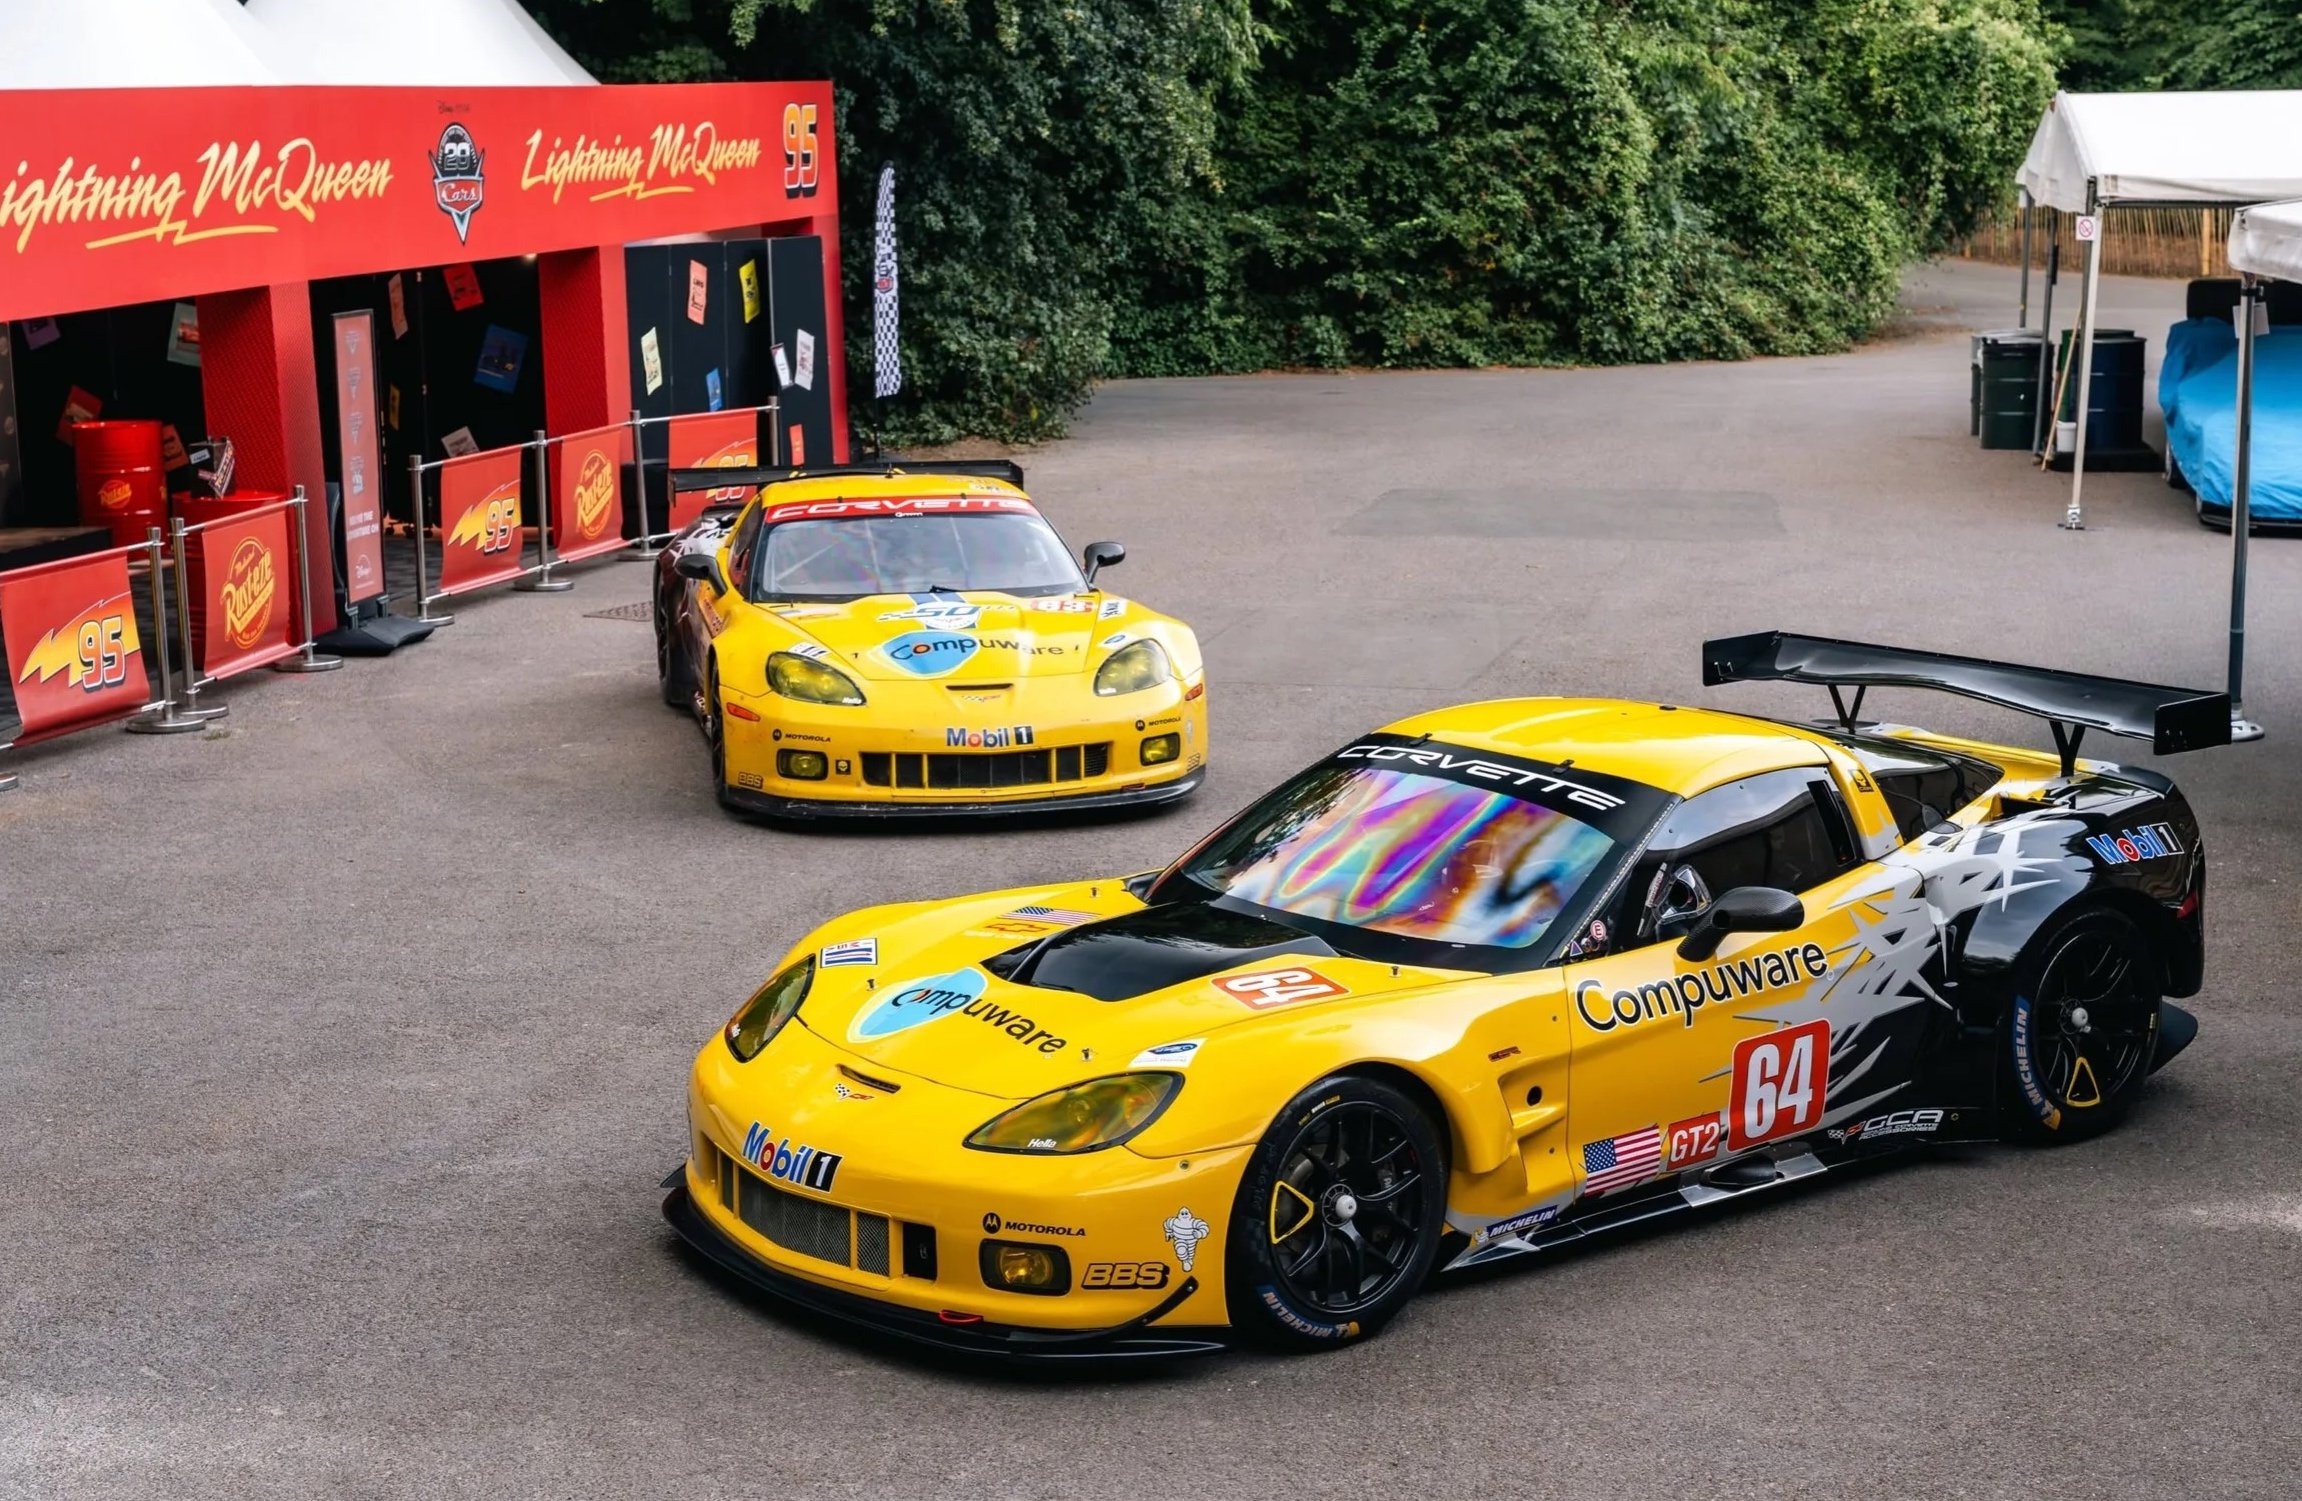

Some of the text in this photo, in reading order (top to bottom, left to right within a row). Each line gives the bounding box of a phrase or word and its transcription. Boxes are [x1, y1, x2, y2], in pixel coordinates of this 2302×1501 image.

[521, 121, 762, 204] Lightning McQueen
[783, 103, 818, 198] 95
[0, 137, 394, 254] ightning McQueen
[440, 181, 478, 203] Cars
[483, 497, 515, 554] 95
[771, 499, 1030, 519] CORVETTE
[78, 614, 127, 692] 95
[889, 637, 1065, 661] Compuware
[785, 733, 831, 742] MOTOROLA
[946, 727, 1010, 747] Mobil
[738, 772, 764, 789] BBS
[1337, 745, 1626, 810] CORVETTE
[2086, 825, 2167, 864] Mobil
[1225, 970, 1335, 1005] 64
[1576, 943, 1828, 1031] Compuware
[892, 988, 1067, 1053] Compuware
[2016, 1007, 2043, 1106] MICHELIN
[1744, 1034, 1814, 1138] 64
[743, 1121, 814, 1183] Mobil
[1027, 1138, 1057, 1148] Hella
[1670, 1122, 1720, 1162] GT2
[1005, 1221, 1086, 1237] MOTOROLA
[1489, 1209, 1555, 1237] MICHELIN
[1082, 1262, 1170, 1290] BBS
[1262, 1292, 1333, 1337] MICHELIN
